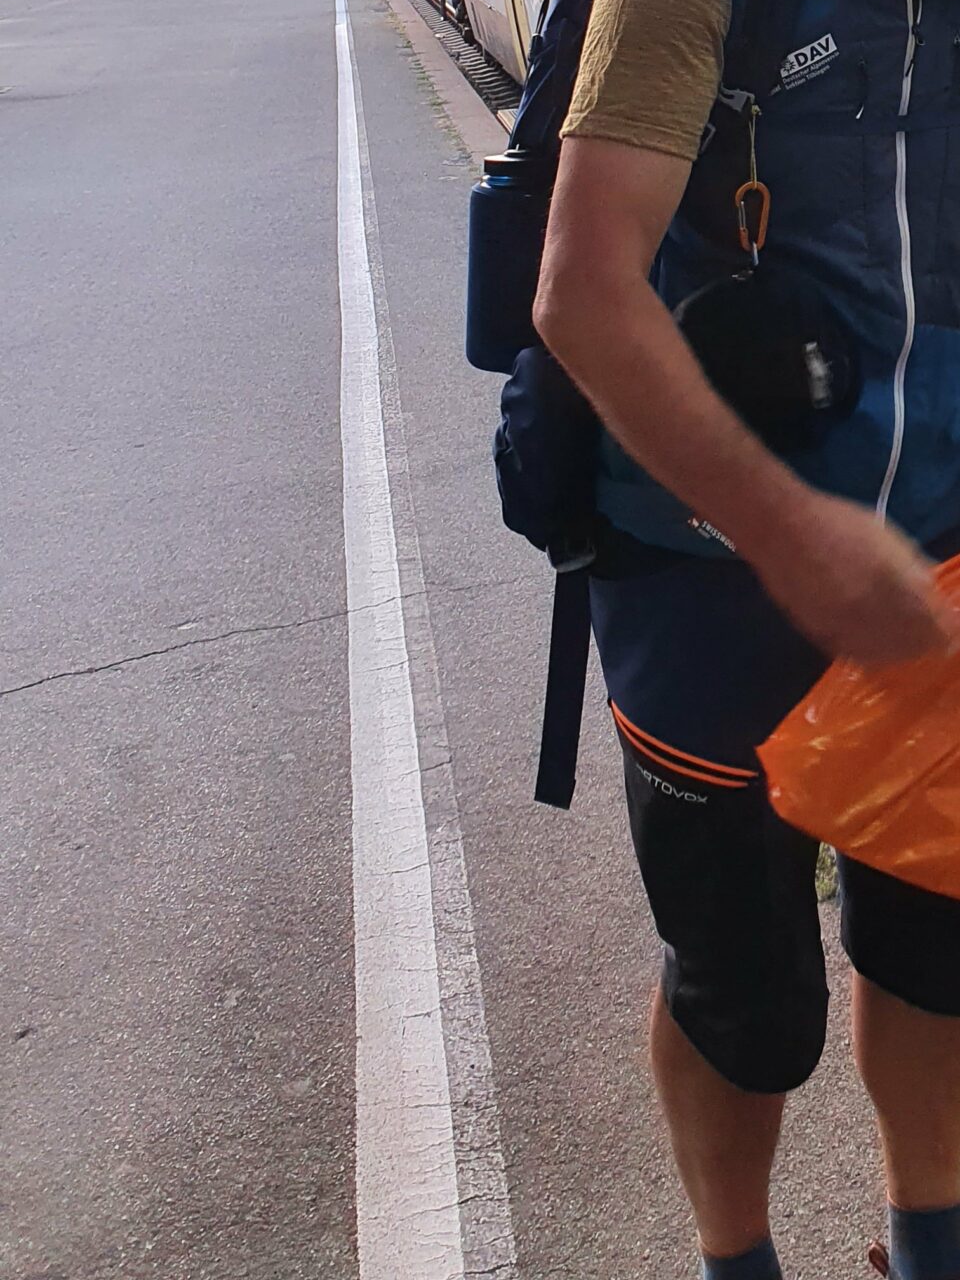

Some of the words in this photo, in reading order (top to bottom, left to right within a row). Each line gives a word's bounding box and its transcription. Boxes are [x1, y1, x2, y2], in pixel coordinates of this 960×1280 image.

[793, 36, 830, 68] DAV
[782, 67, 810, 85] Deutscher
[635, 762, 709, 804] RTOVOX
